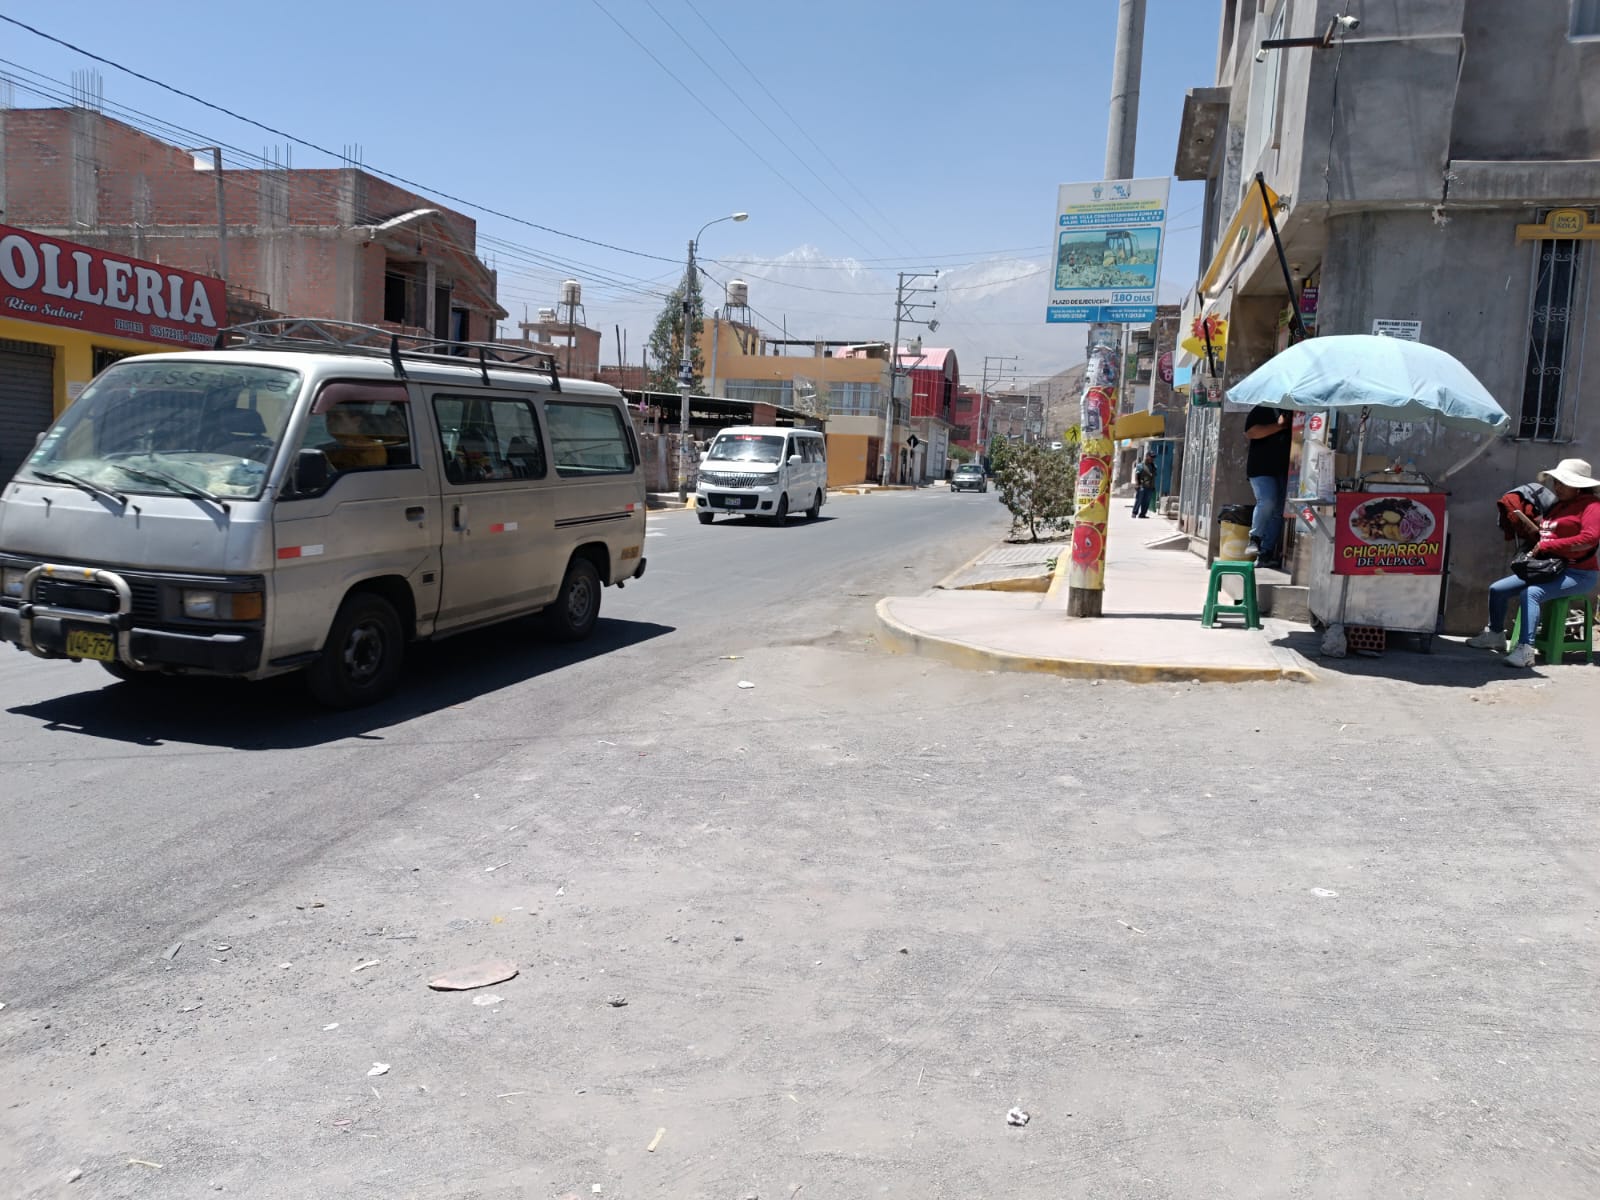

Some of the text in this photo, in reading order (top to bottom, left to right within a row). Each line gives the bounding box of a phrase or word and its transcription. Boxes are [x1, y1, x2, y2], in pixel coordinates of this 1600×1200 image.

[4, 295, 84, 321] Rico Sabor!
[1343, 541, 1439, 558] CHICHARRÓN
[1356, 556, 1427, 567] DE ALPACA
